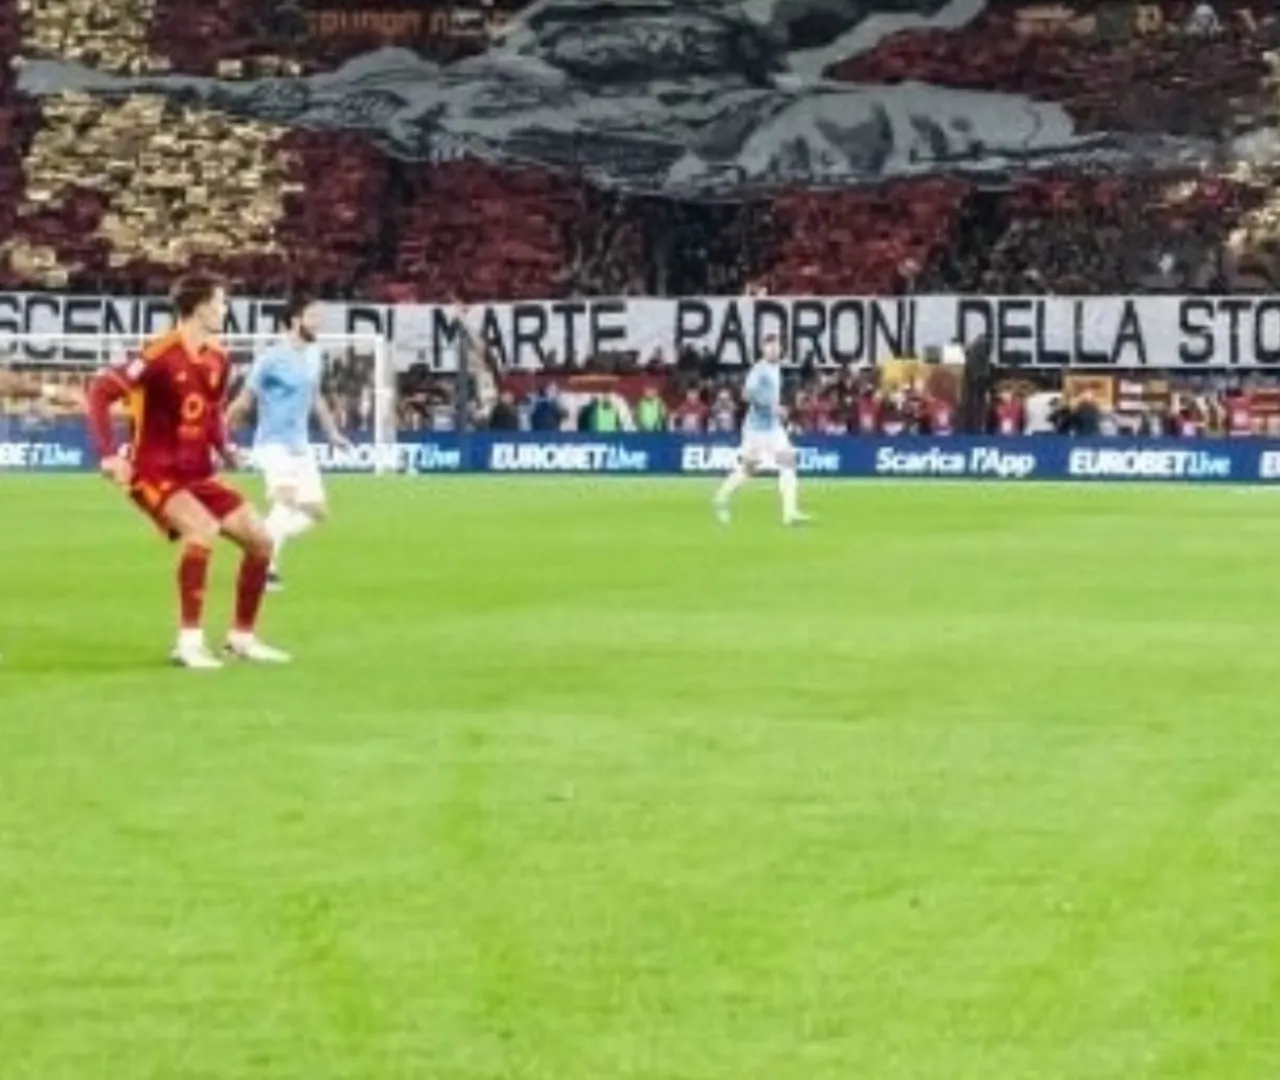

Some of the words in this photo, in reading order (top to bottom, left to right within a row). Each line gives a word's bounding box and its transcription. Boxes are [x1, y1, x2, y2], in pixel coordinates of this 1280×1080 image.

[432, 301, 628, 368] MARTE
[674, 299, 917, 365] PADRONI
[956, 299, 1146, 364] DELLA
[875, 447, 965, 472] Scarica
